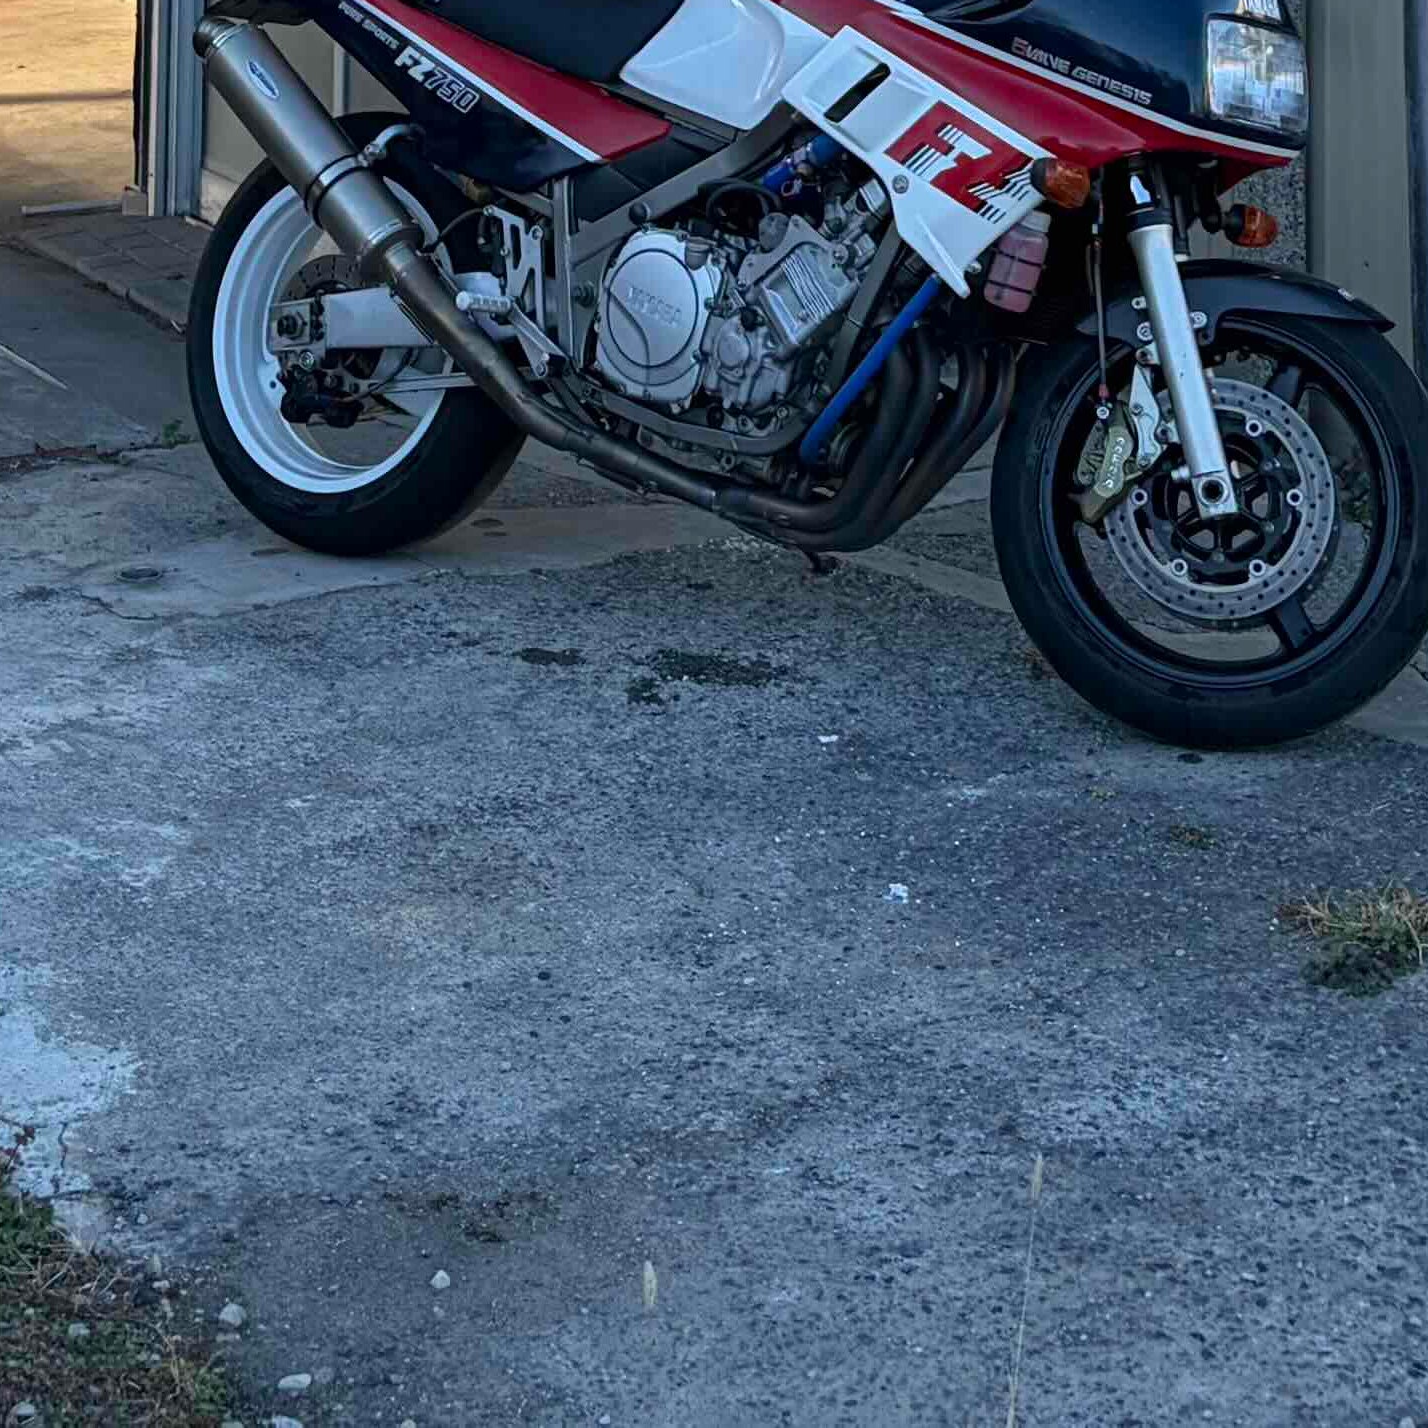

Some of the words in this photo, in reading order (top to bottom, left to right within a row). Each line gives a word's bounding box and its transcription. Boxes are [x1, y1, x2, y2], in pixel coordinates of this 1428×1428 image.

[394, 46, 481, 115] FZ750
[1072, 65, 1154, 106] GENESIS
[882, 99, 1037, 215] FZ
